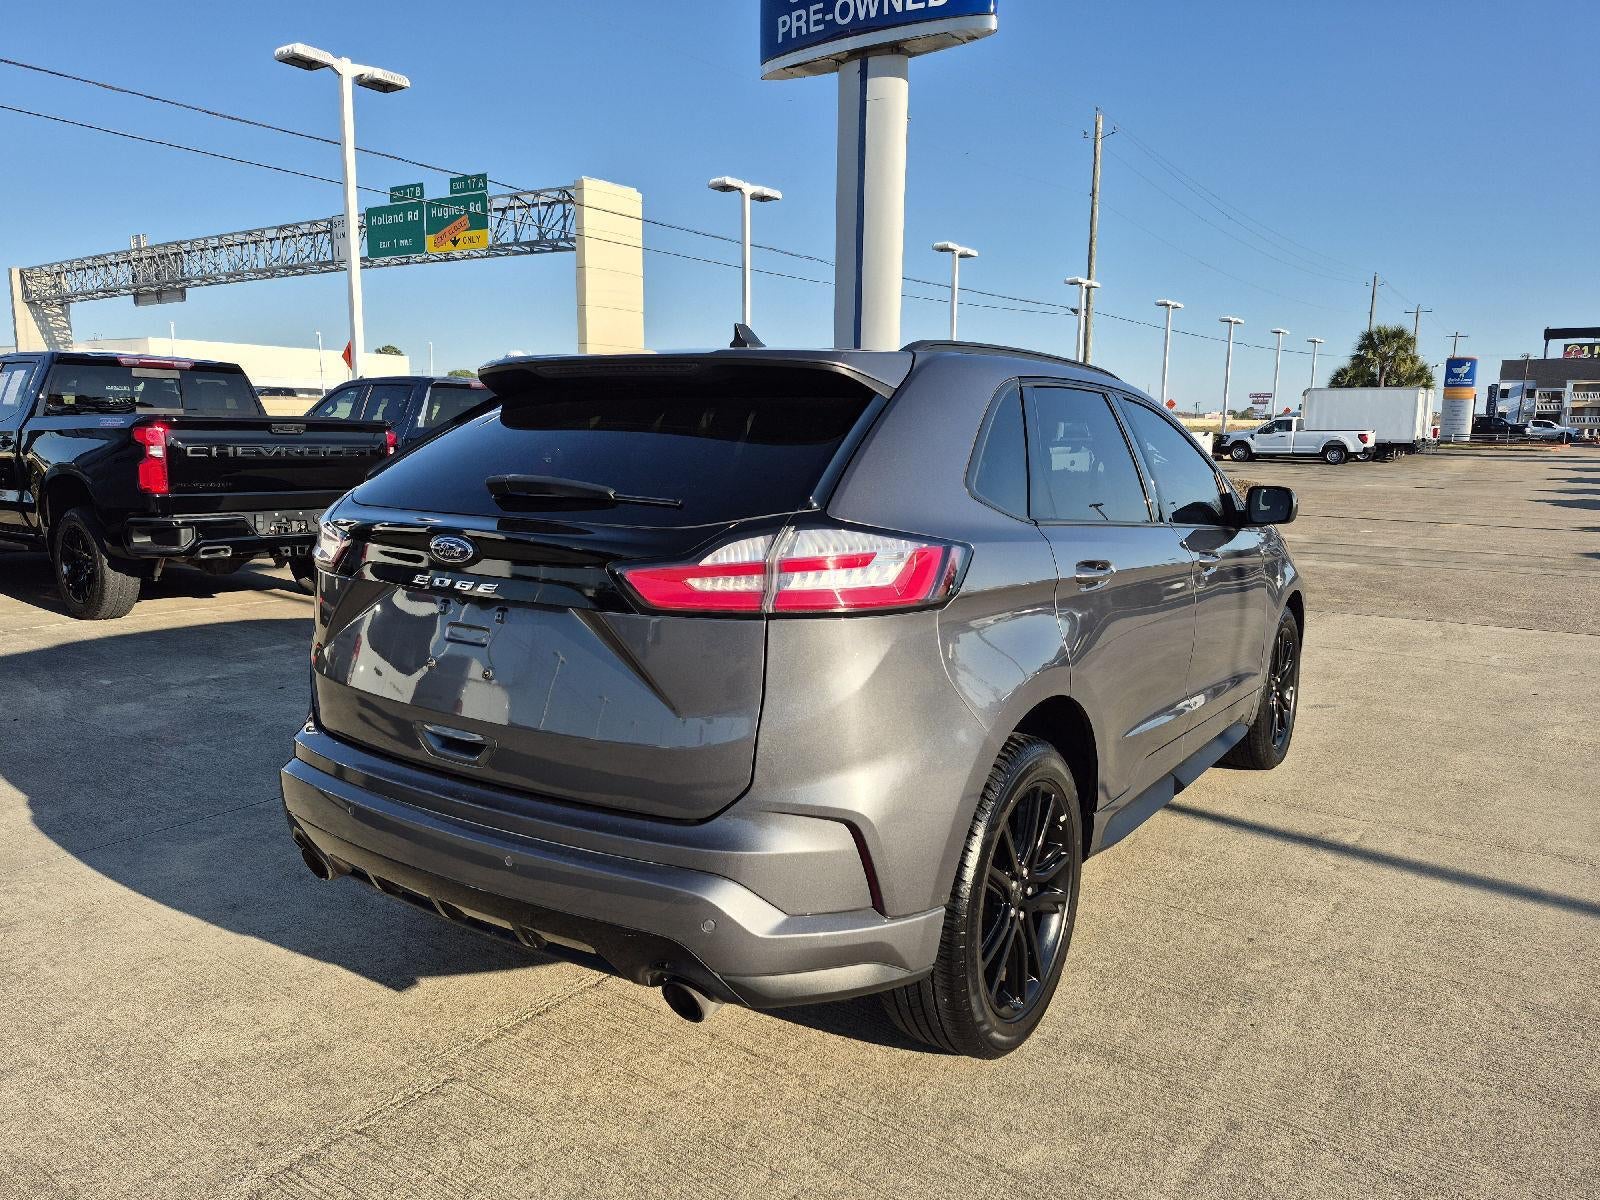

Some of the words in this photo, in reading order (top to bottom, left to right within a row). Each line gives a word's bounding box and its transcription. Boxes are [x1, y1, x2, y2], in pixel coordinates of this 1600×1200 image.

[777, 0, 949, 44] PRE-OWN
[452, 181, 465, 190] EXIT
[371, 213, 404, 226] Holland
[407, 209, 419, 221] Rd
[431, 205, 465, 219] Hughes
[469, 201, 481, 213] Rd
[379, 240, 391, 249] EXIT
[393, 238, 397, 248] 1
[399, 238, 413, 247] MILE
[462, 235, 481, 245] ONLY
[186, 445, 377, 458] CHEVROLET
[412, 574, 499, 594] EDGE
